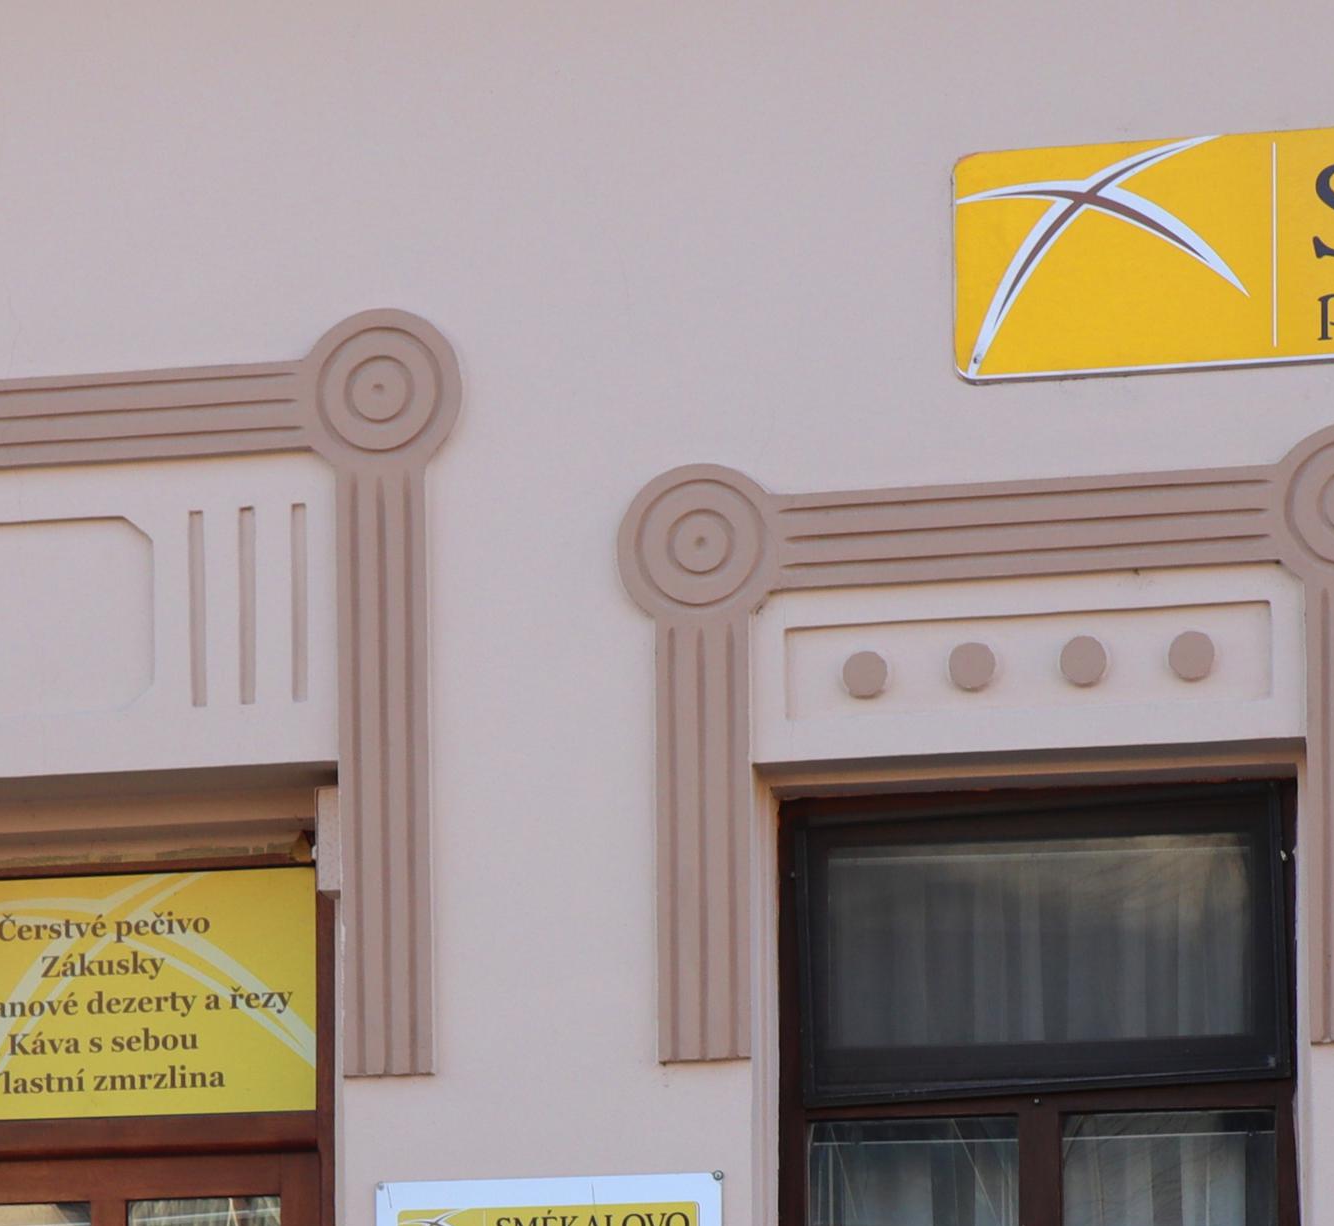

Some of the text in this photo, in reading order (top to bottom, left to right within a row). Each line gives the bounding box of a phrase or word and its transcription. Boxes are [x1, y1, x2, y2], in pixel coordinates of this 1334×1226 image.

[114, 911, 211, 944] pečivo
[41, 951, 165, 980] Zákusky
[86, 989, 197, 1018] dezerty
[205, 993, 220, 1010] a
[230, 985, 293, 1013] řezy
[8, 1028, 198, 1056] Káva s sebou
[93, 1065, 225, 1091] zmrzlina
